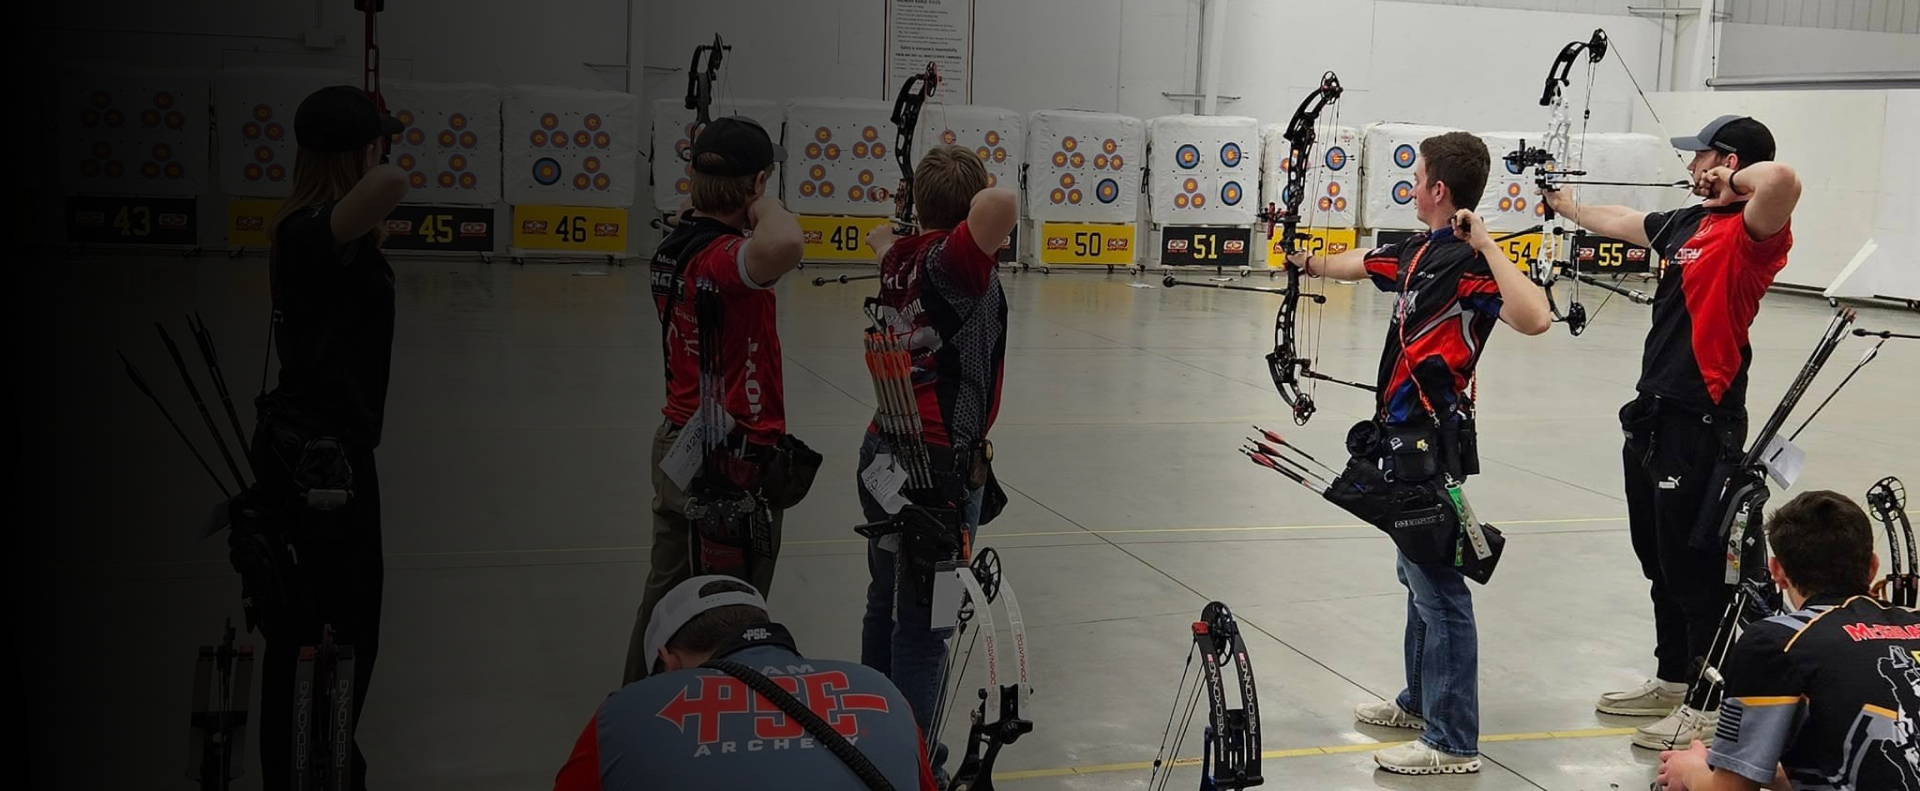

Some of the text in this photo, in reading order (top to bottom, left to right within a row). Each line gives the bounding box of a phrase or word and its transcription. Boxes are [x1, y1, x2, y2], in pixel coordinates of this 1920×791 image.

[113, 205, 151, 236] 43
[418, 214, 453, 243] 45
[555, 215, 587, 242] 46
[830, 226, 858, 251] 48
[1075, 232, 1101, 256] 50
[1193, 234, 1218, 259] 51
[1510, 241, 1531, 263] 54
[1598, 243, 1624, 267] 55
[651, 270, 685, 295] HOT
[747, 628, 768, 641] PSE
[695, 671, 860, 745] PSE
[693, 737, 859, 758] ARCHEY
